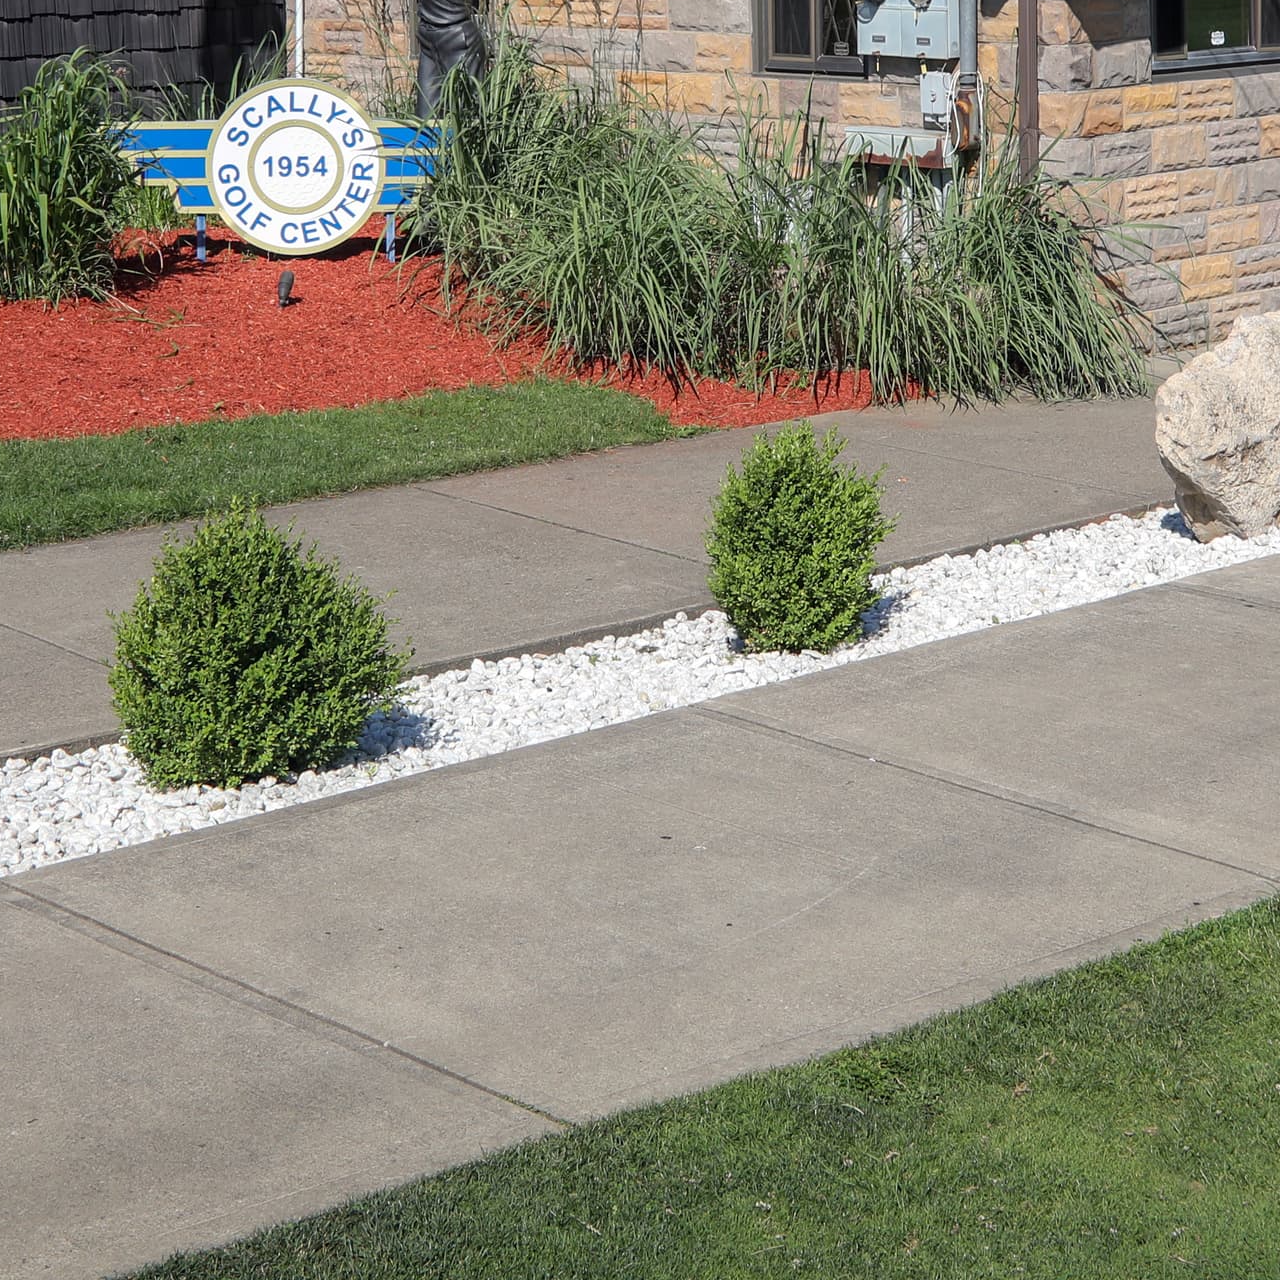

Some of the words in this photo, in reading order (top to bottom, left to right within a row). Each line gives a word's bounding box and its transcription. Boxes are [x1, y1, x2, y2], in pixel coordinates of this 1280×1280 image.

[226, 91, 365, 148] SCALLY'S
[262, 155, 329, 178] 1954
[218, 163, 273, 232] GOLF
[280, 161, 375, 245] CENTER
